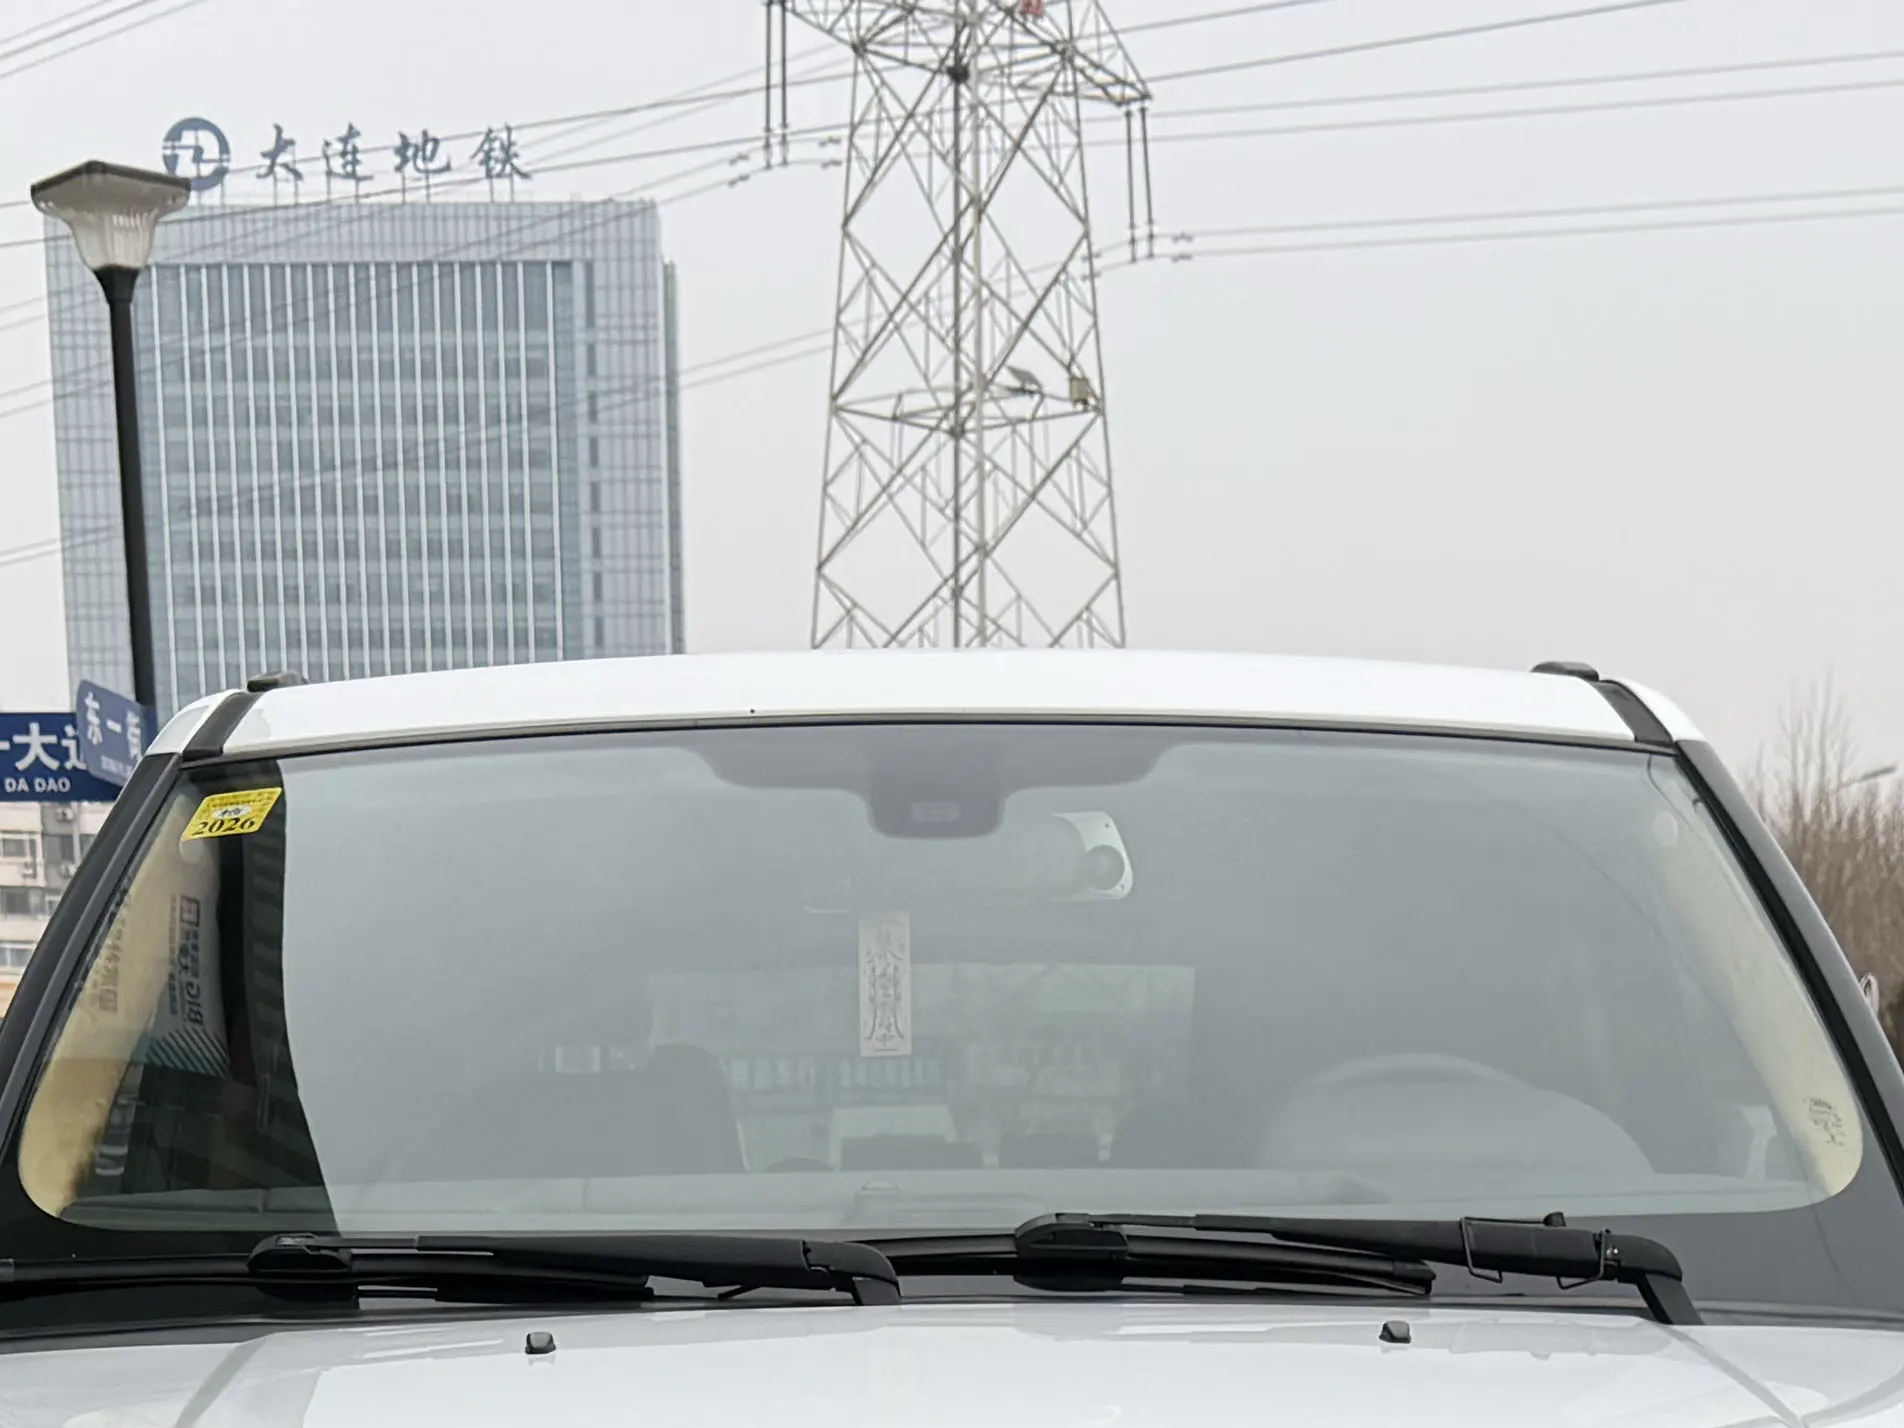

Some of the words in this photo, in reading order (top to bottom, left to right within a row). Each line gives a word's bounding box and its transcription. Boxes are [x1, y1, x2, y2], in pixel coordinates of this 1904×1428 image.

[256, 121, 533, 181] 大连地铁
[5, 778, 29, 793] DA
[33, 778, 71, 793] DAO
[192, 817, 255, 837] 2026
